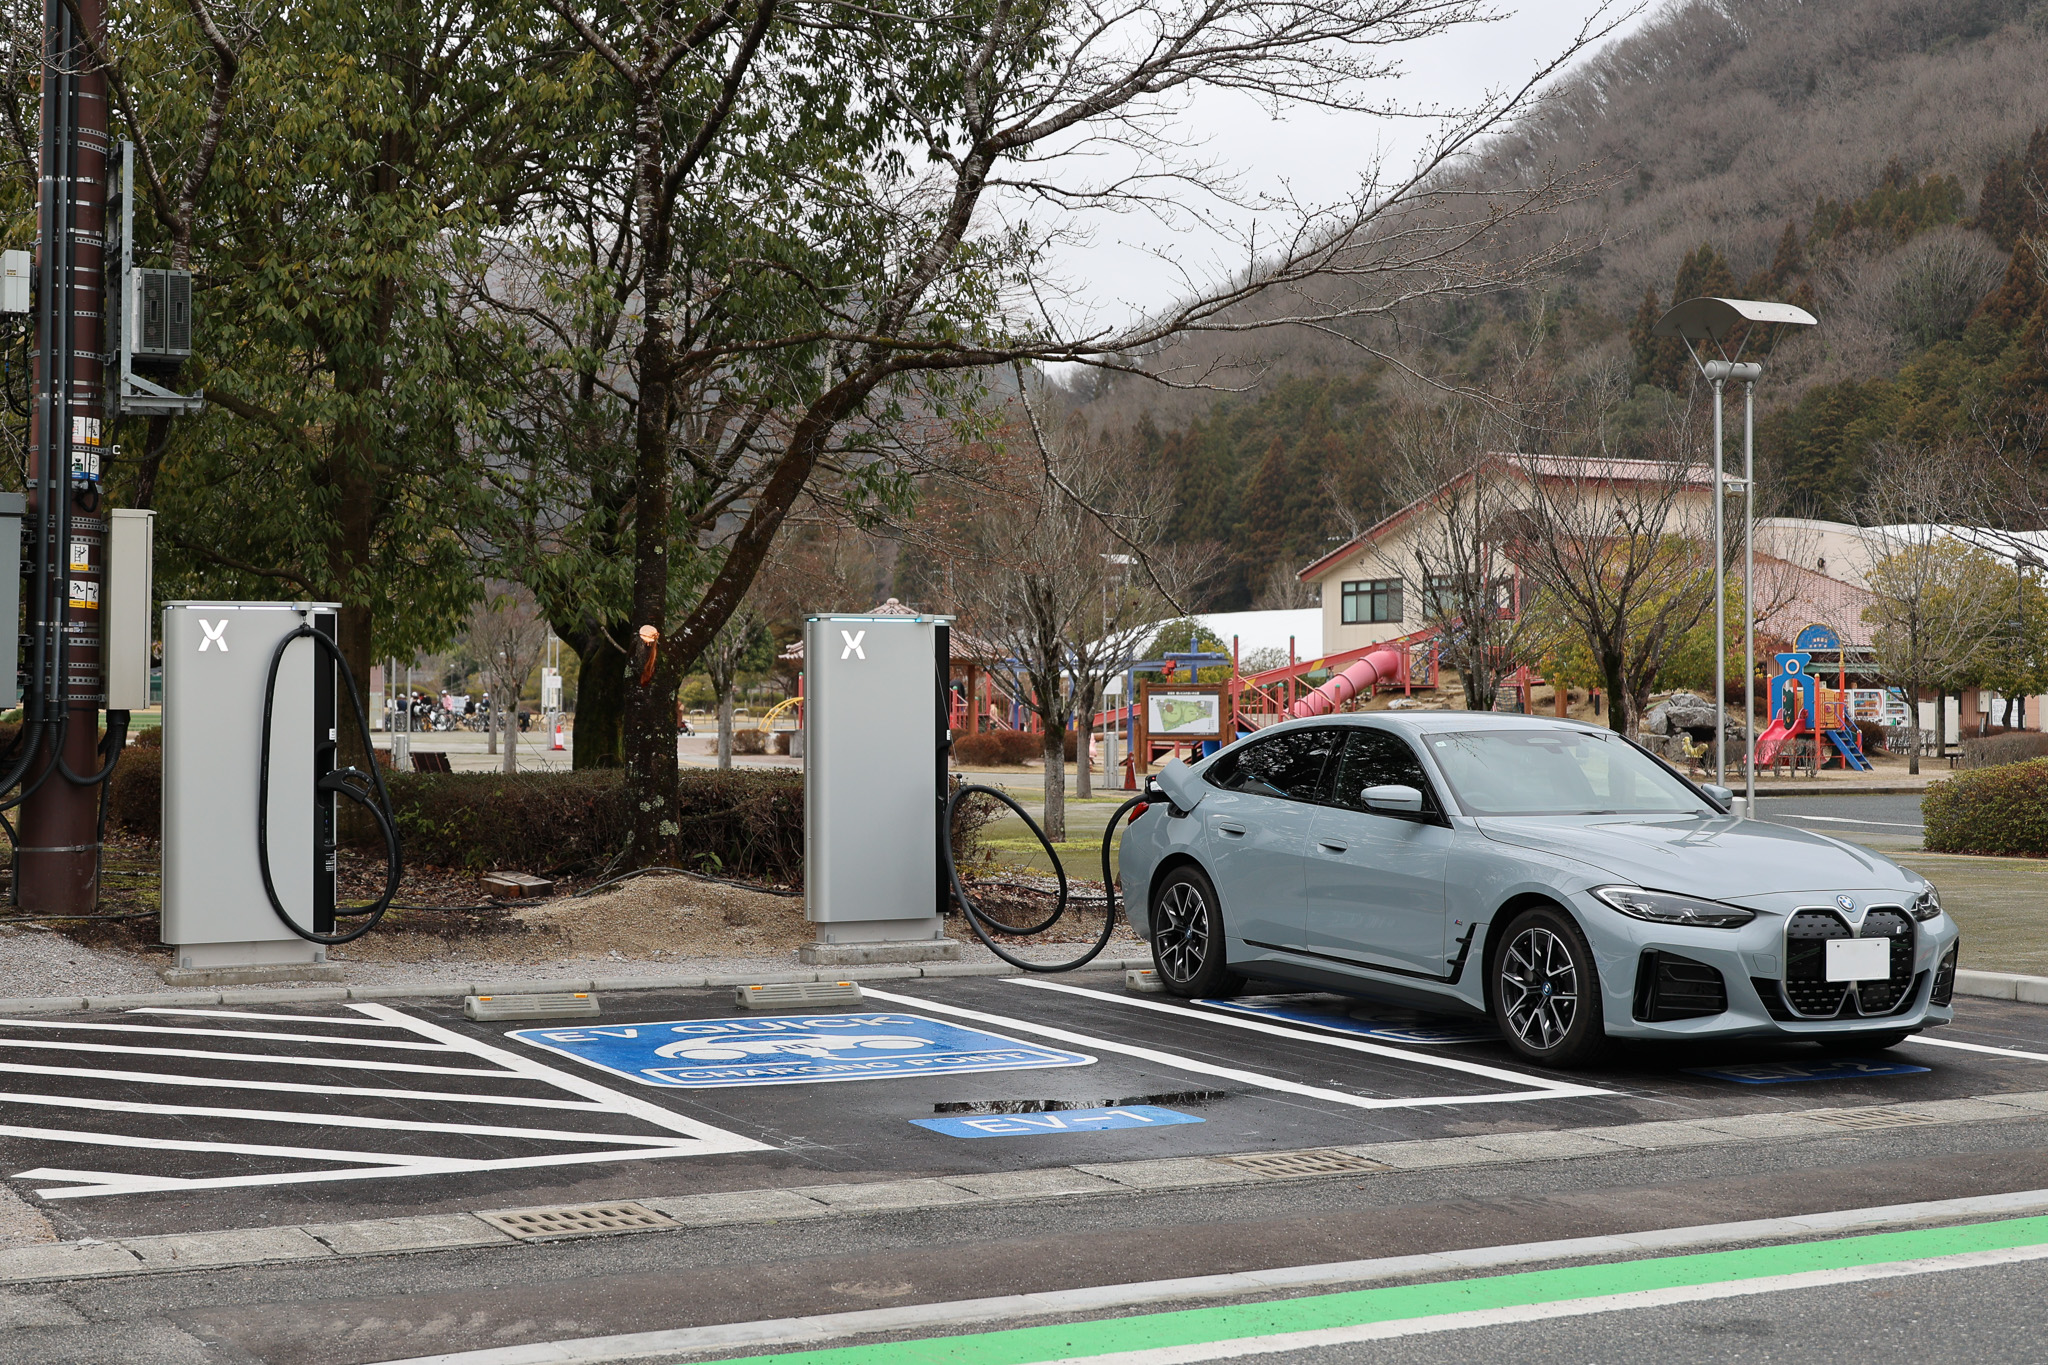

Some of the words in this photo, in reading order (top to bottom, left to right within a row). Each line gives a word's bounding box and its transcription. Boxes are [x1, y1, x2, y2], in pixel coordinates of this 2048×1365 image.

[541, 1028, 638, 1042] EV
[670, 1016, 914, 1034] QUICK
[678, 1060, 900, 1079] CHARGING
[904, 1052, 1028, 1066] POINT
[1716, 1062, 1893, 1080] EV-2
[961, 1110, 1154, 1132] EV-1
